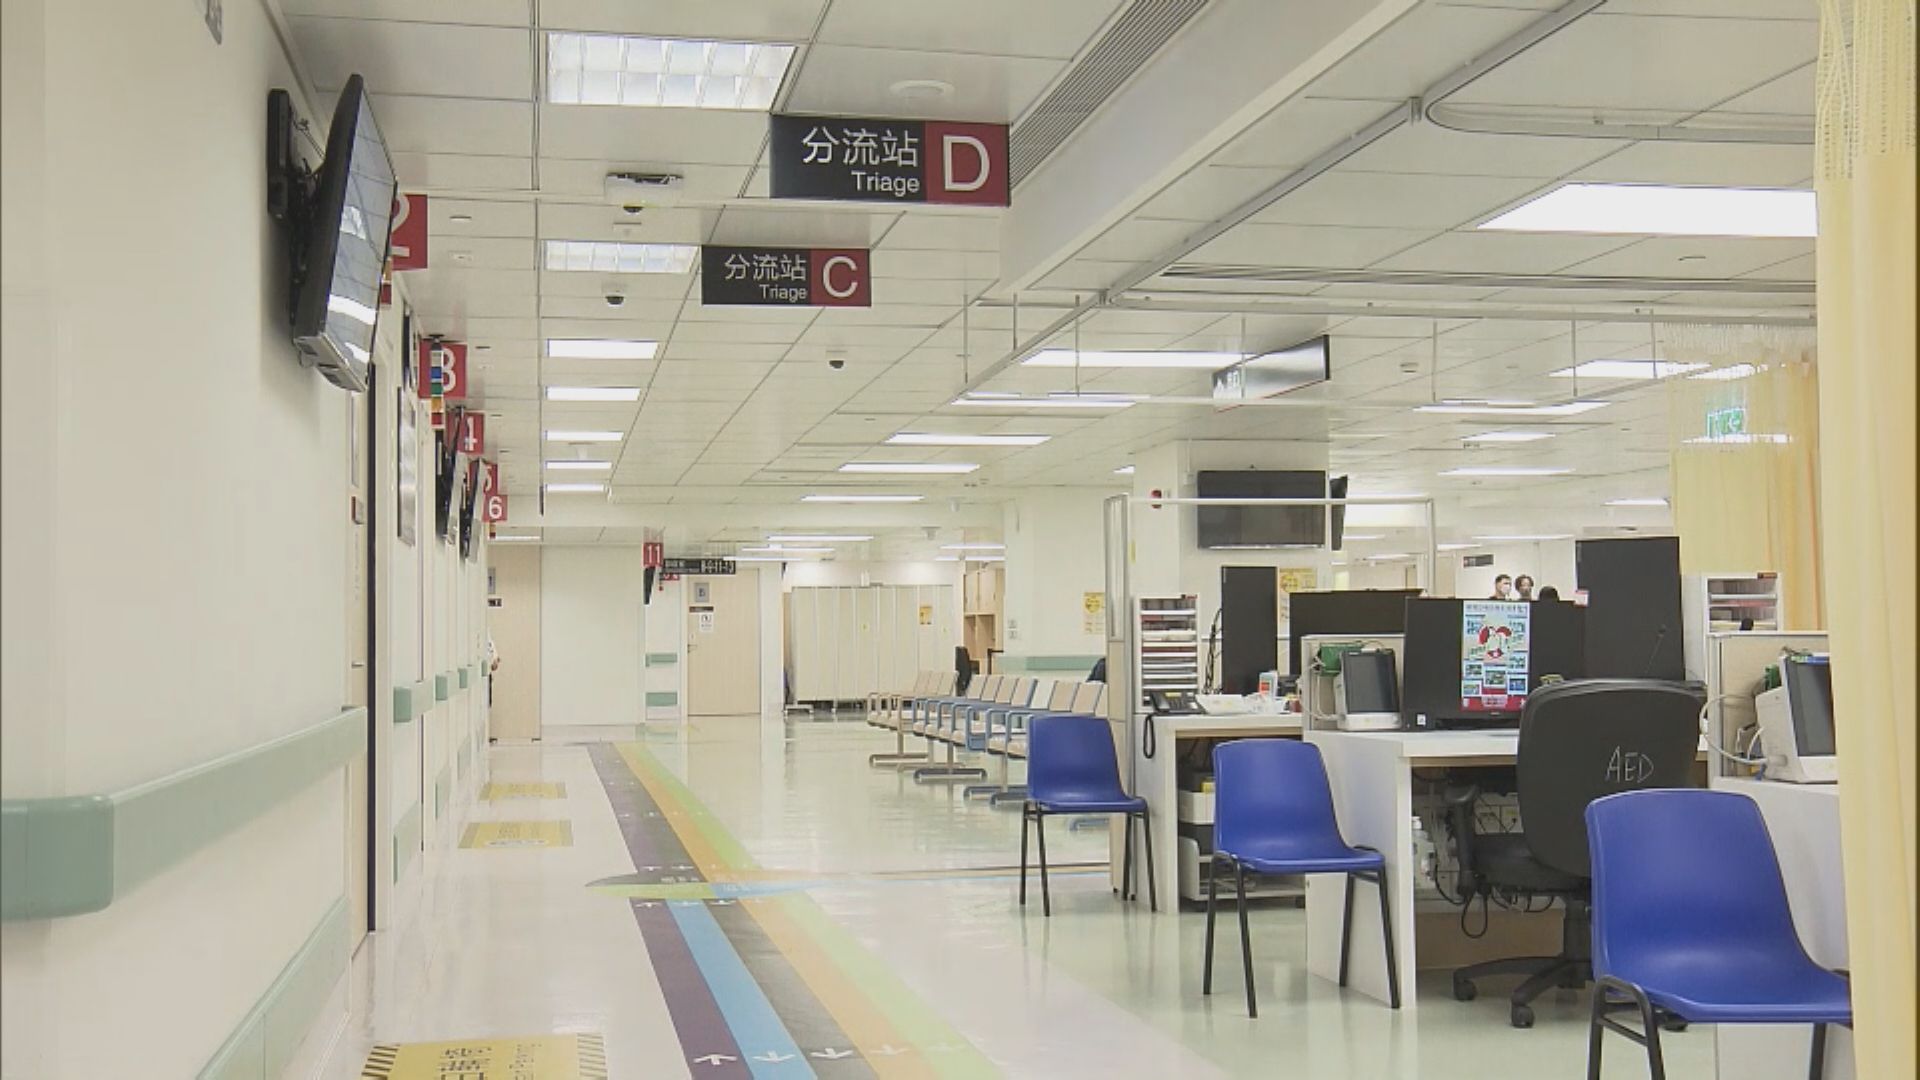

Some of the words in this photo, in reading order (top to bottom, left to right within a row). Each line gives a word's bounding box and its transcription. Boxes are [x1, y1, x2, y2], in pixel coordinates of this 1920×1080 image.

[802, 126, 919, 167] 分流站
[943, 134, 991, 192] D
[851, 170, 920, 197] Triage
[724, 253, 807, 281] 分流站
[822, 255, 859, 298] C
[759, 284, 808, 302] Triage
[489, 496, 502, 519] 6
[648, 544, 661, 564] 11
[1605, 746, 1655, 784] AED
